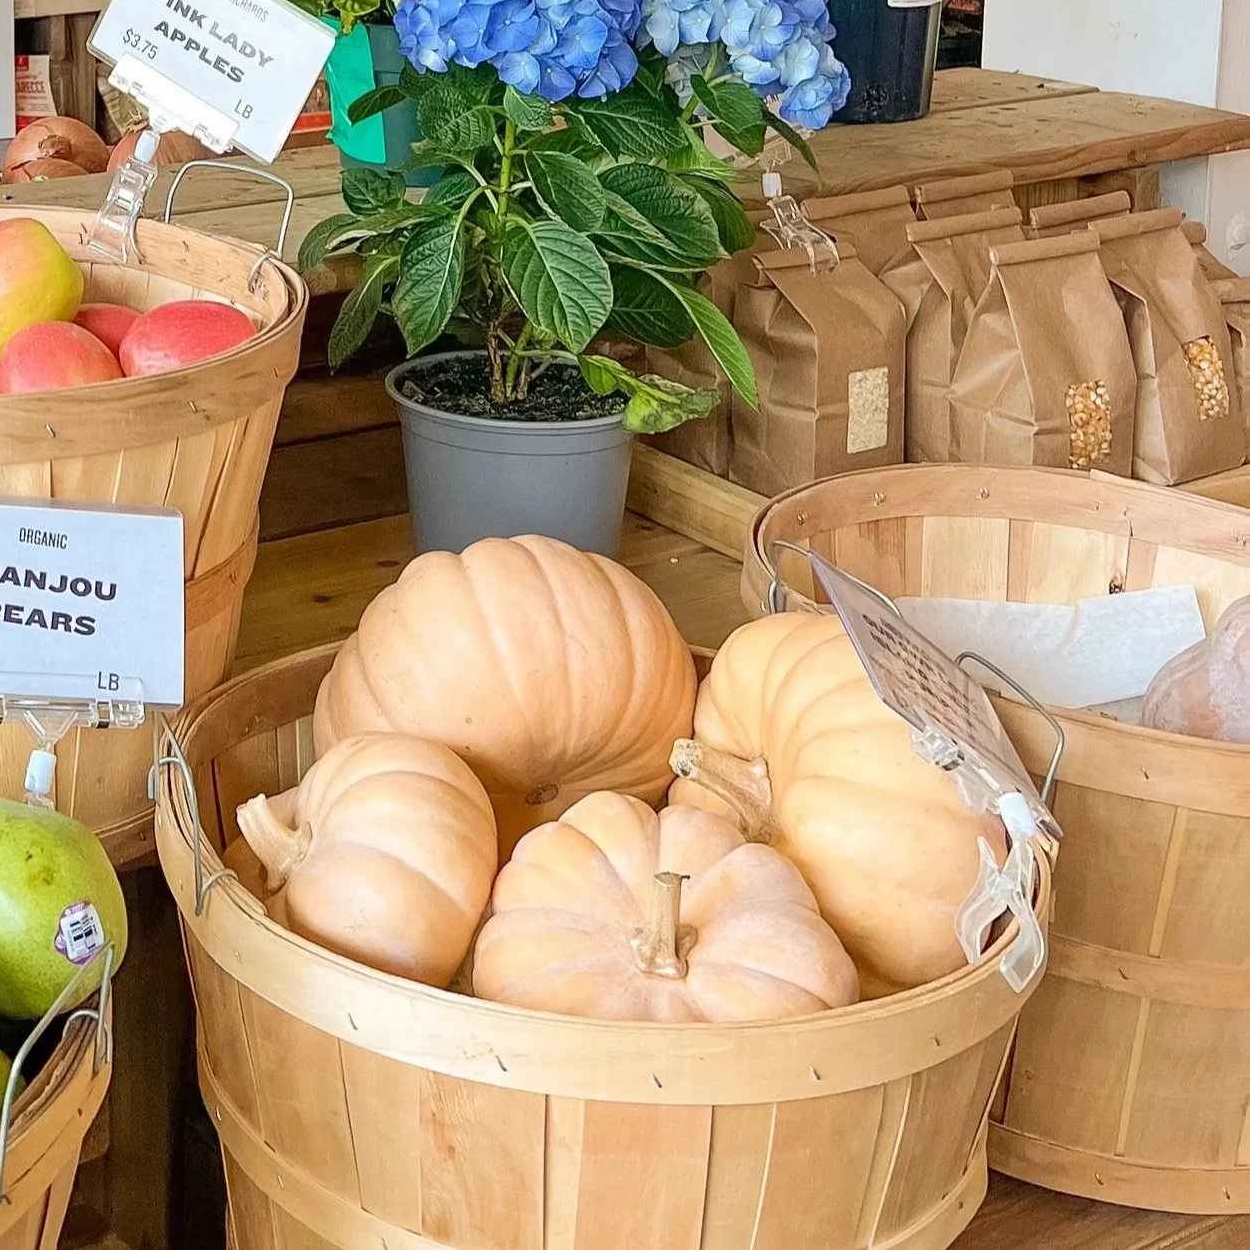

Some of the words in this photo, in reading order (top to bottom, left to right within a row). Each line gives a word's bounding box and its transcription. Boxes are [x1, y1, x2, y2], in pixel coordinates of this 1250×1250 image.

[122, 28, 159, 60] $3.75
[154, 21, 245, 83] APPLES
[209, 21, 274, 68] LADY
[234, 98, 254, 119] LB
[18, 527, 68, 549] ORGANIC
[98, 671, 120, 692] LB
